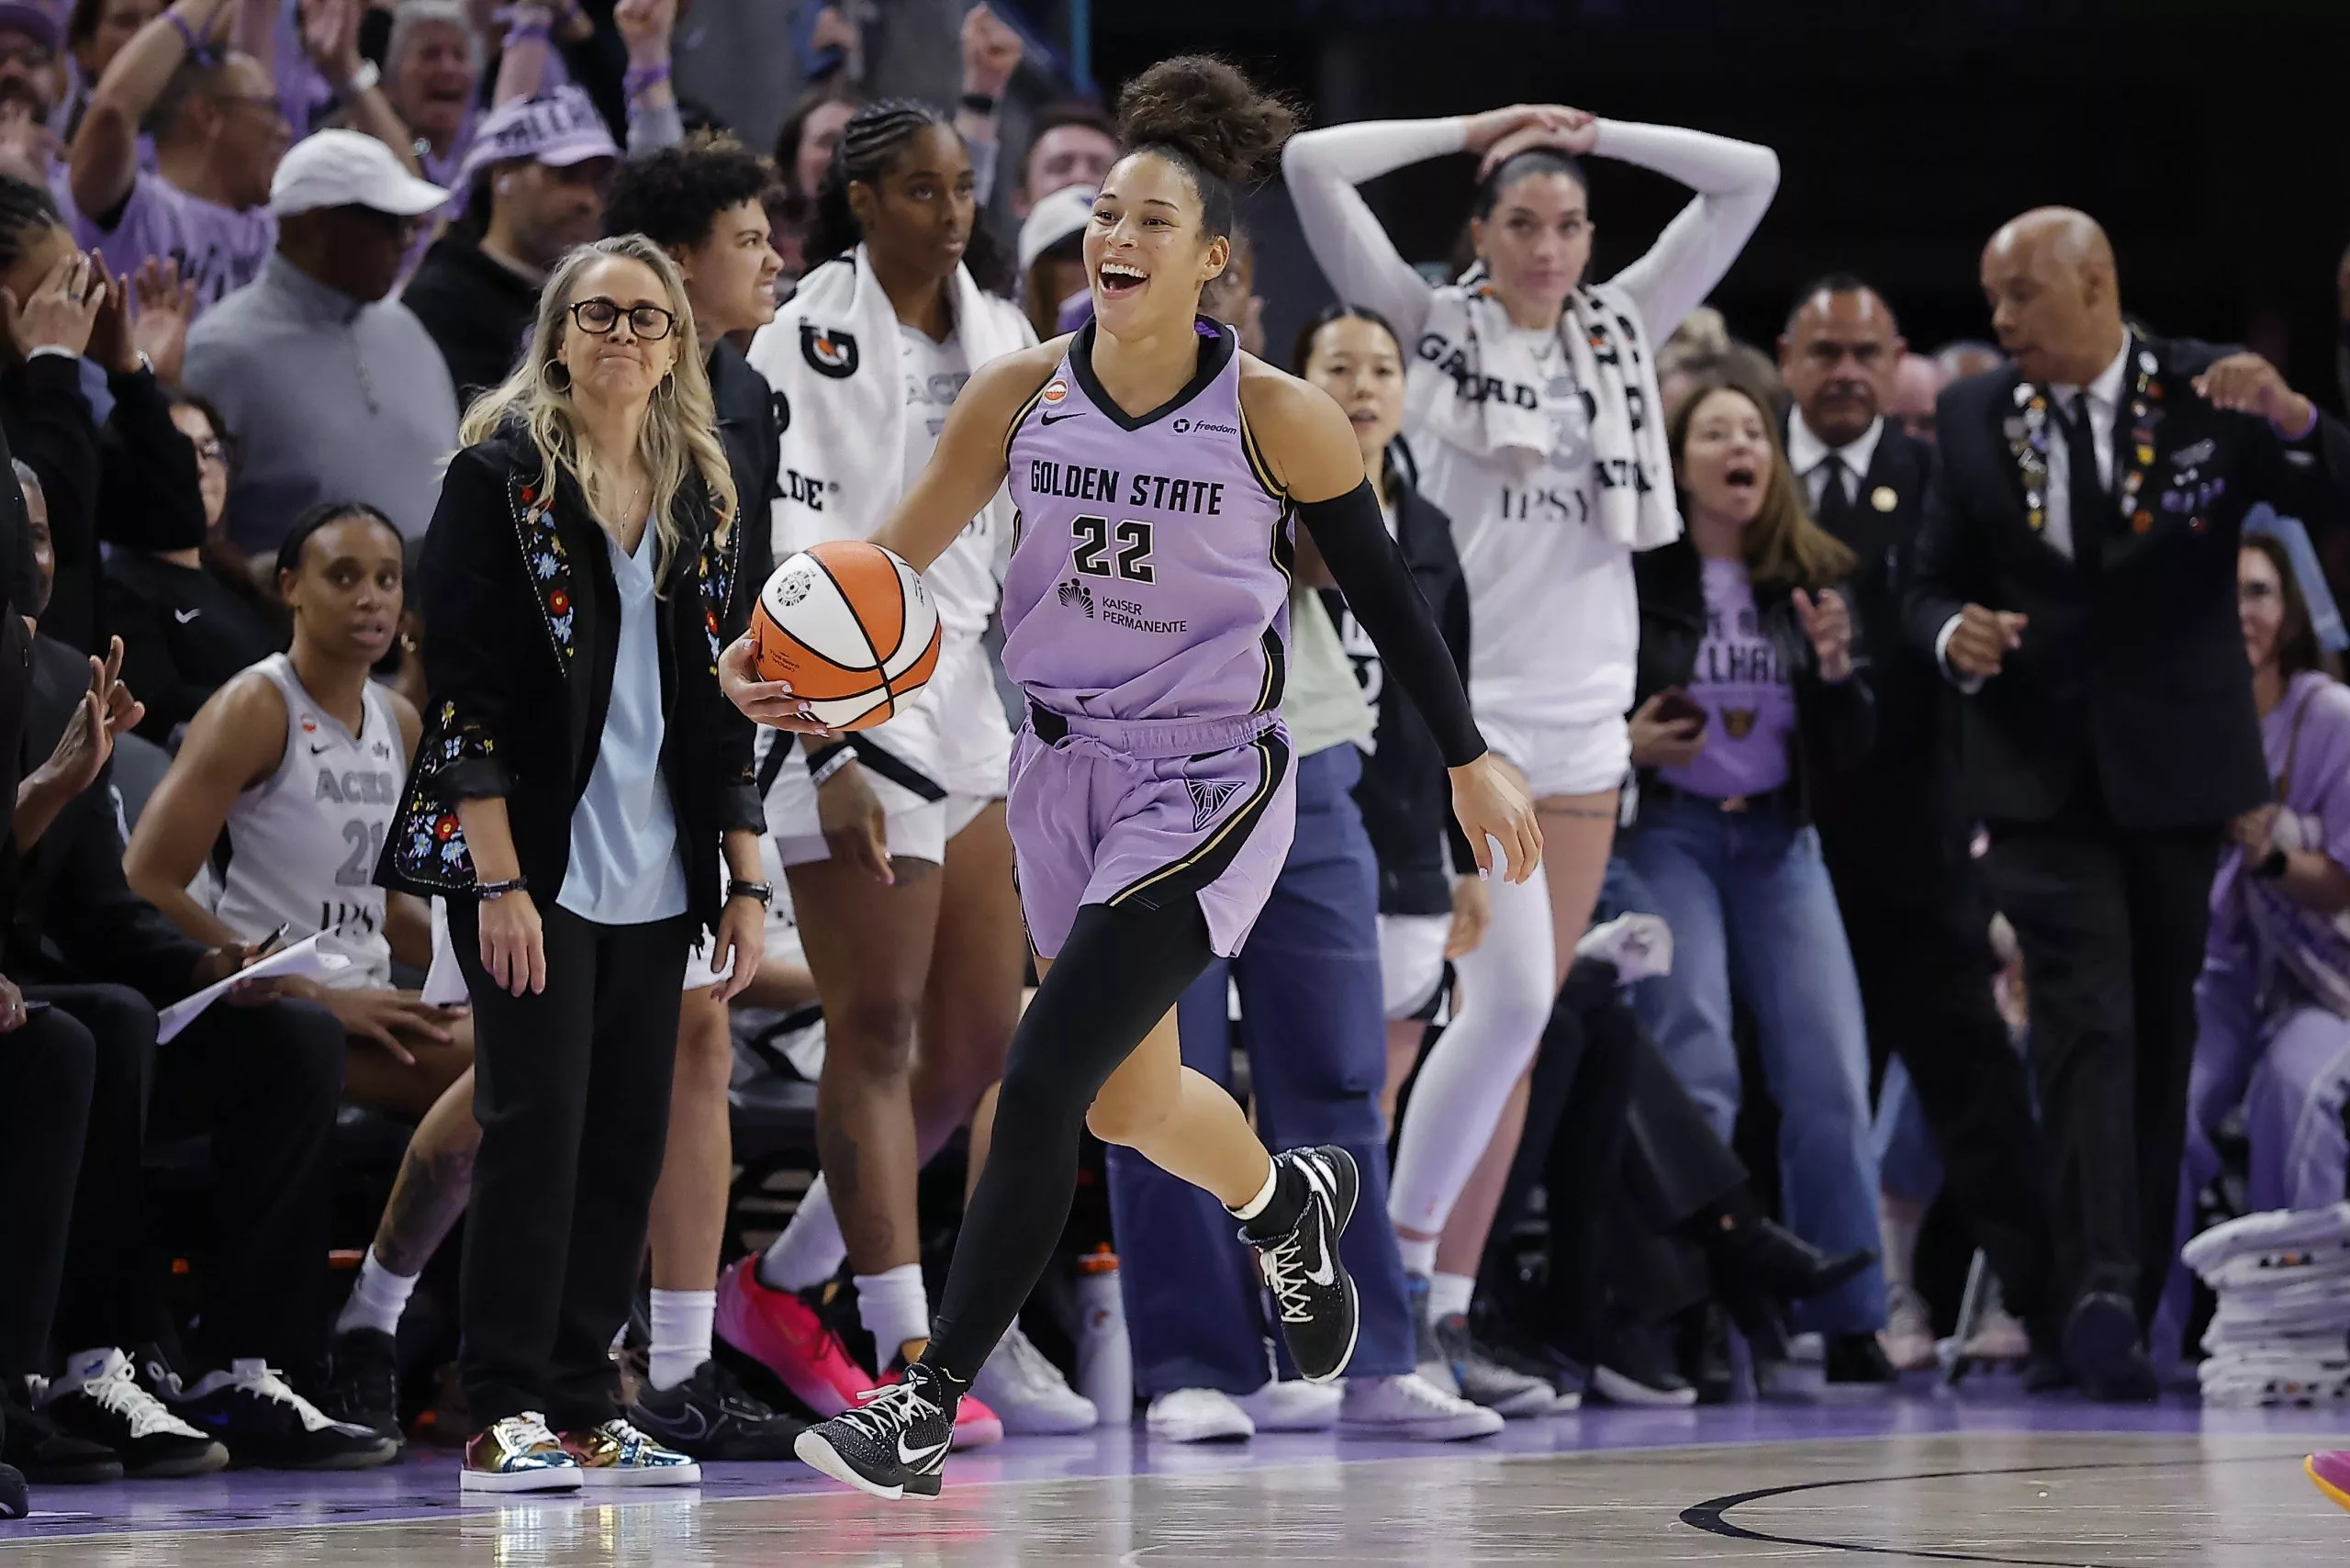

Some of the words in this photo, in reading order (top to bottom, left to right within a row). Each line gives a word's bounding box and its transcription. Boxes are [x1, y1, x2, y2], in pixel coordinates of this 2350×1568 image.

[1192, 420, 1237, 435] freedom
[1031, 459, 1120, 503] GOLDEN
[1129, 474, 1225, 516] STATE
[1070, 513, 1157, 586] 22
[1102, 595, 1143, 616] KAISER
[1102, 610, 1188, 634] PERMANENTE
[314, 767, 396, 806] ACES
[334, 817, 385, 888] 21
